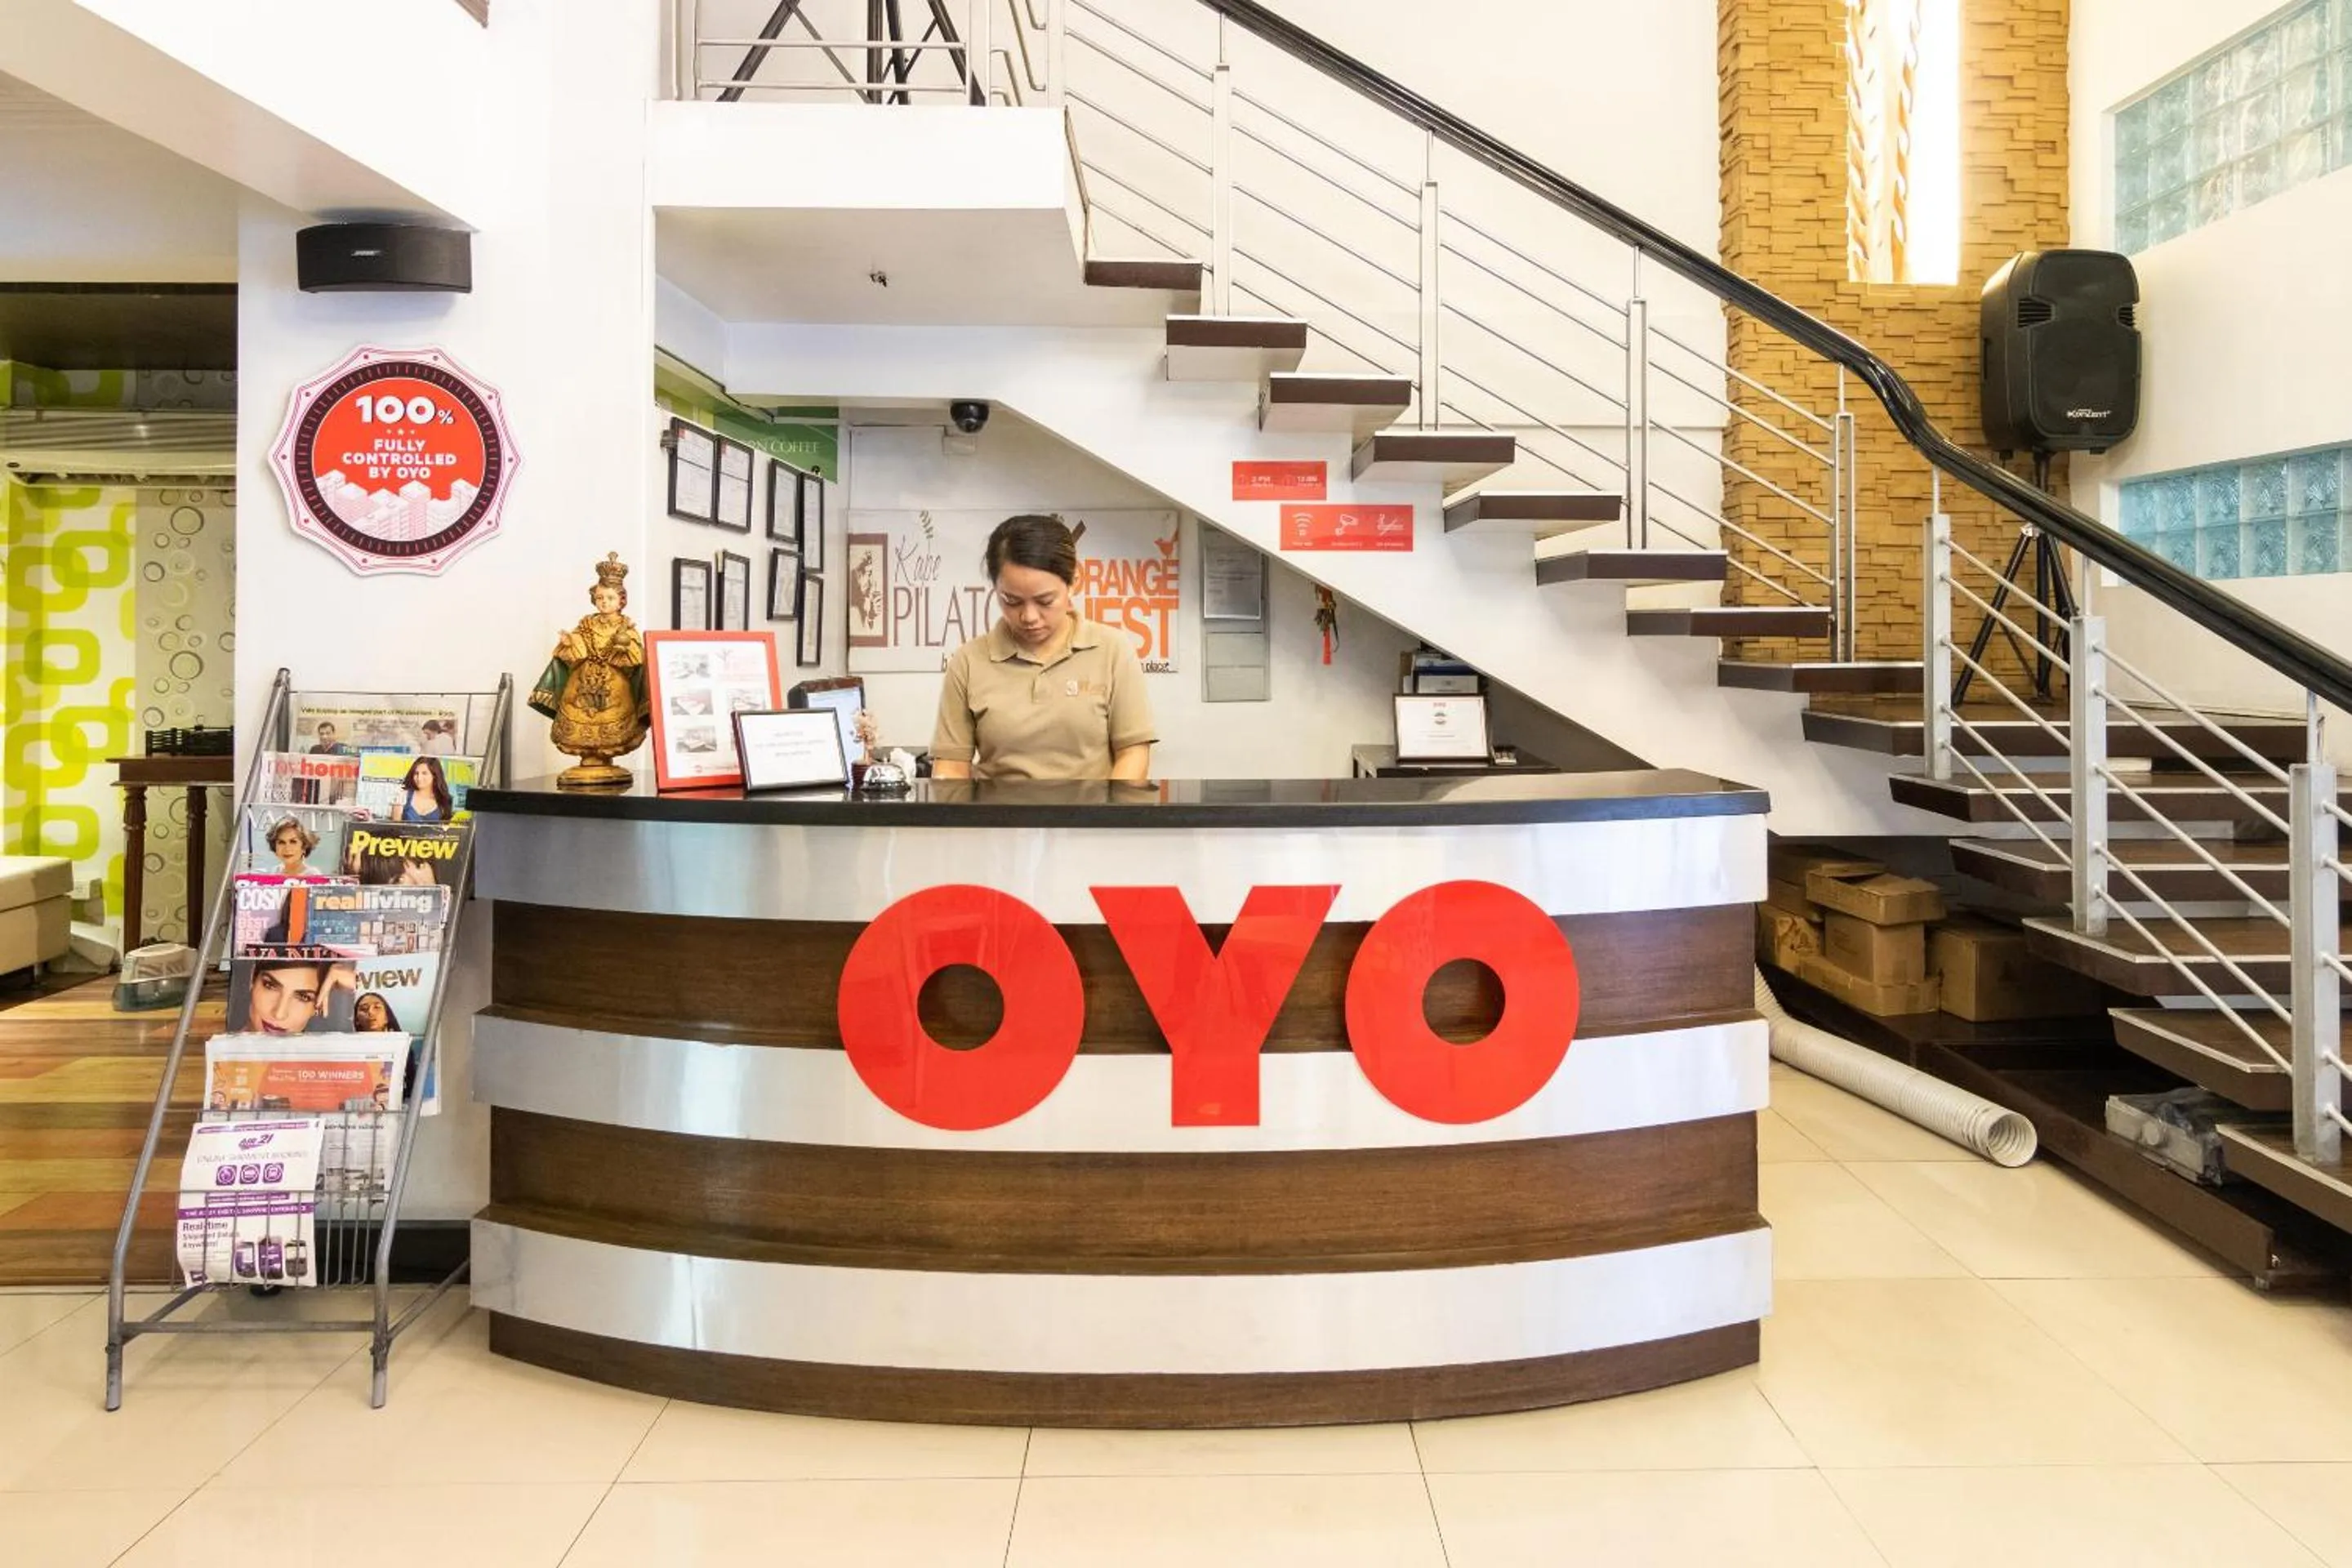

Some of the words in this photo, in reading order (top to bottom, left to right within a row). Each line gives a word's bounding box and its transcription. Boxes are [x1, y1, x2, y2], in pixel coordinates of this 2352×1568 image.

[356, 395, 454, 425] 100%
[374, 439, 425, 452] FULLY
[341, 452, 457, 466] CONTROLLED
[369, 466, 390, 479] BY
[396, 466, 431, 479] OYO
[350, 830, 459, 859] Preview
[838, 880, 1580, 1131] OYO
